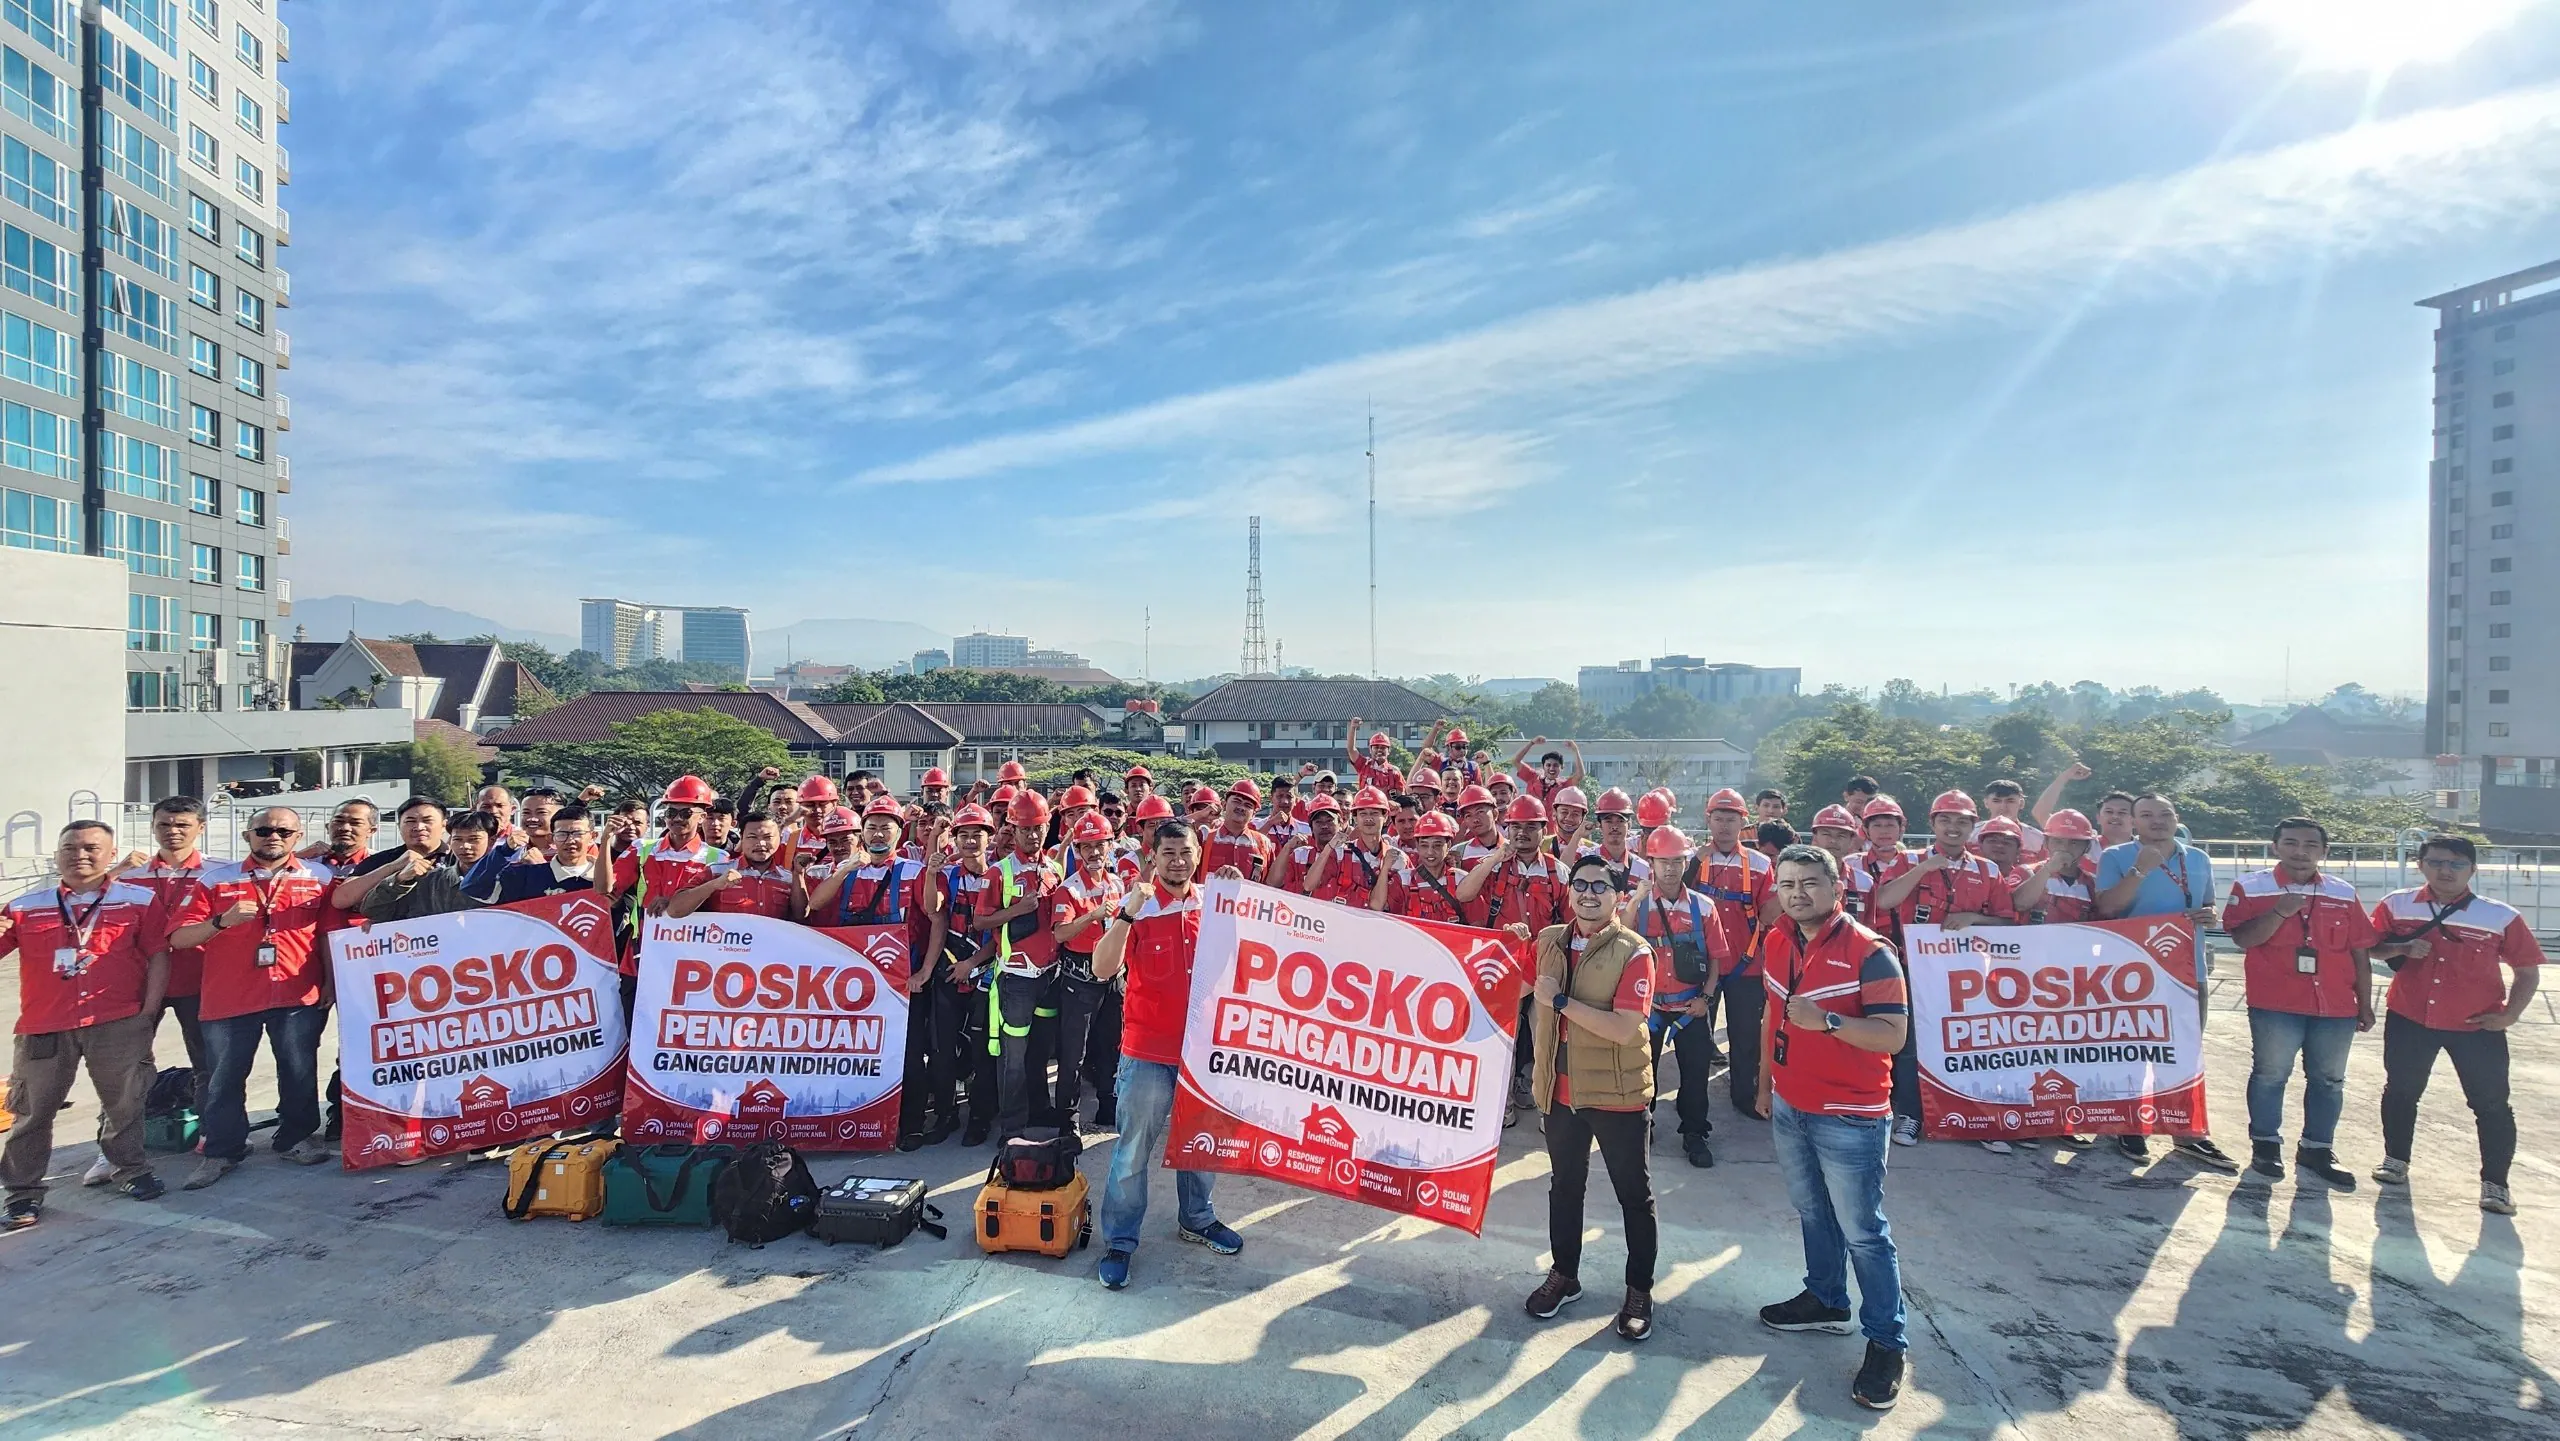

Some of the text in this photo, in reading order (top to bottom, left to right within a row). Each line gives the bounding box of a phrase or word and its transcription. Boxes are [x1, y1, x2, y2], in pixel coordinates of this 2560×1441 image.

[1215, 892, 1326, 934] IndiHome
[345, 932, 439, 961] IndiHome
[653, 923, 753, 945] IndiHome
[1292, 929, 1325, 943] Telkomsel
[1917, 936, 2021, 954] IndiHome
[374, 944, 577, 1019] POSKO
[671, 959, 876, 1013] POSKO
[1232, 938, 1471, 1045] POSKO
[1948, 961, 2154, 1013] POSKO
[378, 993, 592, 1059] PENGADUAN
[664, 1014, 879, 1050] PENGADUAN
[1949, 1008, 2165, 1049] PENGADUAN
[372, 1029, 604, 1086] GANGGUAN INDIHOME
[1219, 1003, 1472, 1096] PENGADUAN
[1945, 1045, 2176, 1073] GANGGUAN INDIHOME
[653, 1052, 881, 1077] GANGGUAN INDIHOME
[1209, 1051, 1475, 1130] GANGGUAN INDIHOME
[1216, 1148, 1240, 1158] CEPAT
[1218, 1137, 1249, 1149] LAYANAN
[1307, 1131, 1349, 1151] IndiHome
[1285, 1159, 1322, 1174] & SOLUTIF
[1287, 1149, 1326, 1165] RESPONSIF
[1360, 1168, 1393, 1184] STANDBY
[1360, 1178, 1402, 1197] UNTUK ANDA
[1442, 1189, 1470, 1204] SOLUSI
[1442, 1200, 1472, 1215] TERBAIK
